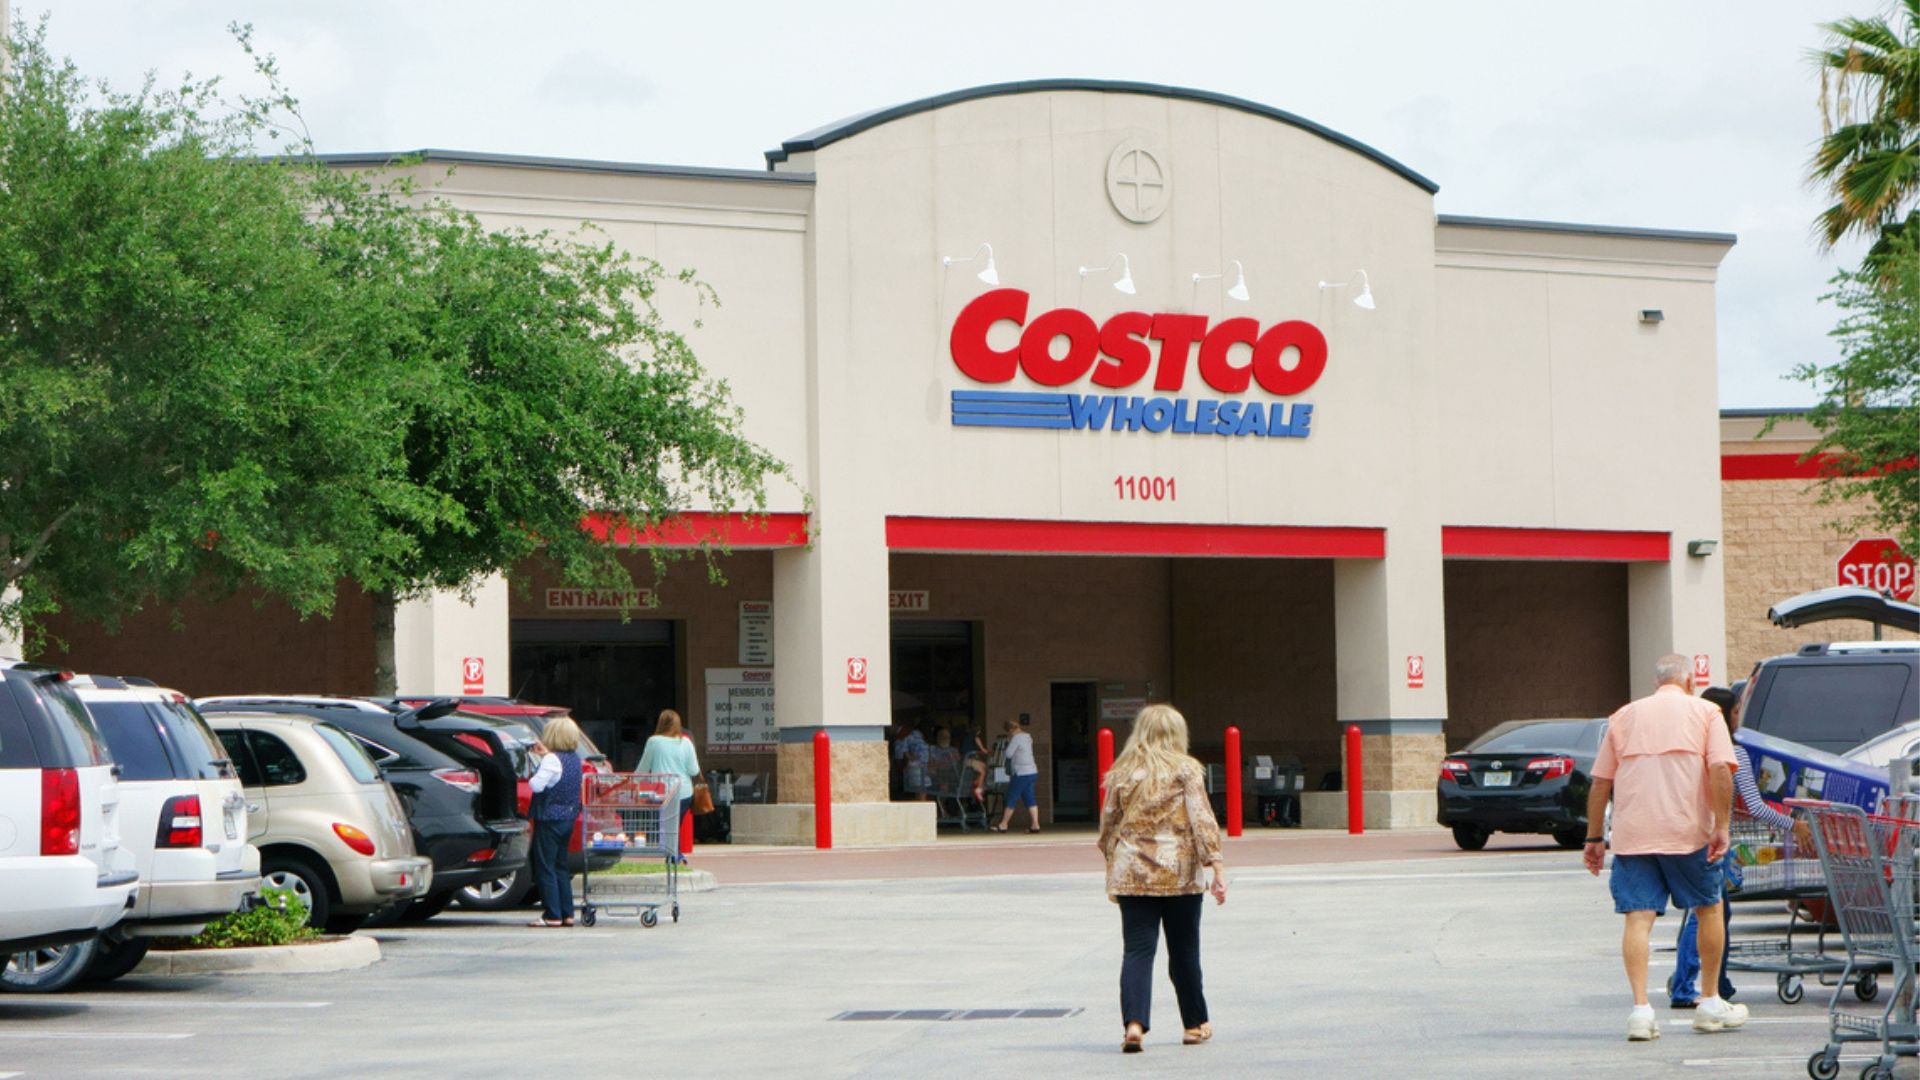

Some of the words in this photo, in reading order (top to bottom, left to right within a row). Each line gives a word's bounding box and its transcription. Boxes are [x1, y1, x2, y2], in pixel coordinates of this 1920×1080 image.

[950, 288, 1328, 396] COSTCO
[1068, 394, 1314, 438] WHOLESALE
[1114, 475, 1176, 501] 11001
[1843, 562, 1911, 592] STOP
[889, 592, 924, 608] EXIT
[728, 687, 766, 697] MEMBERS
[715, 717, 754, 727] SATURDAY
[715, 732, 745, 742] SUNDAY
